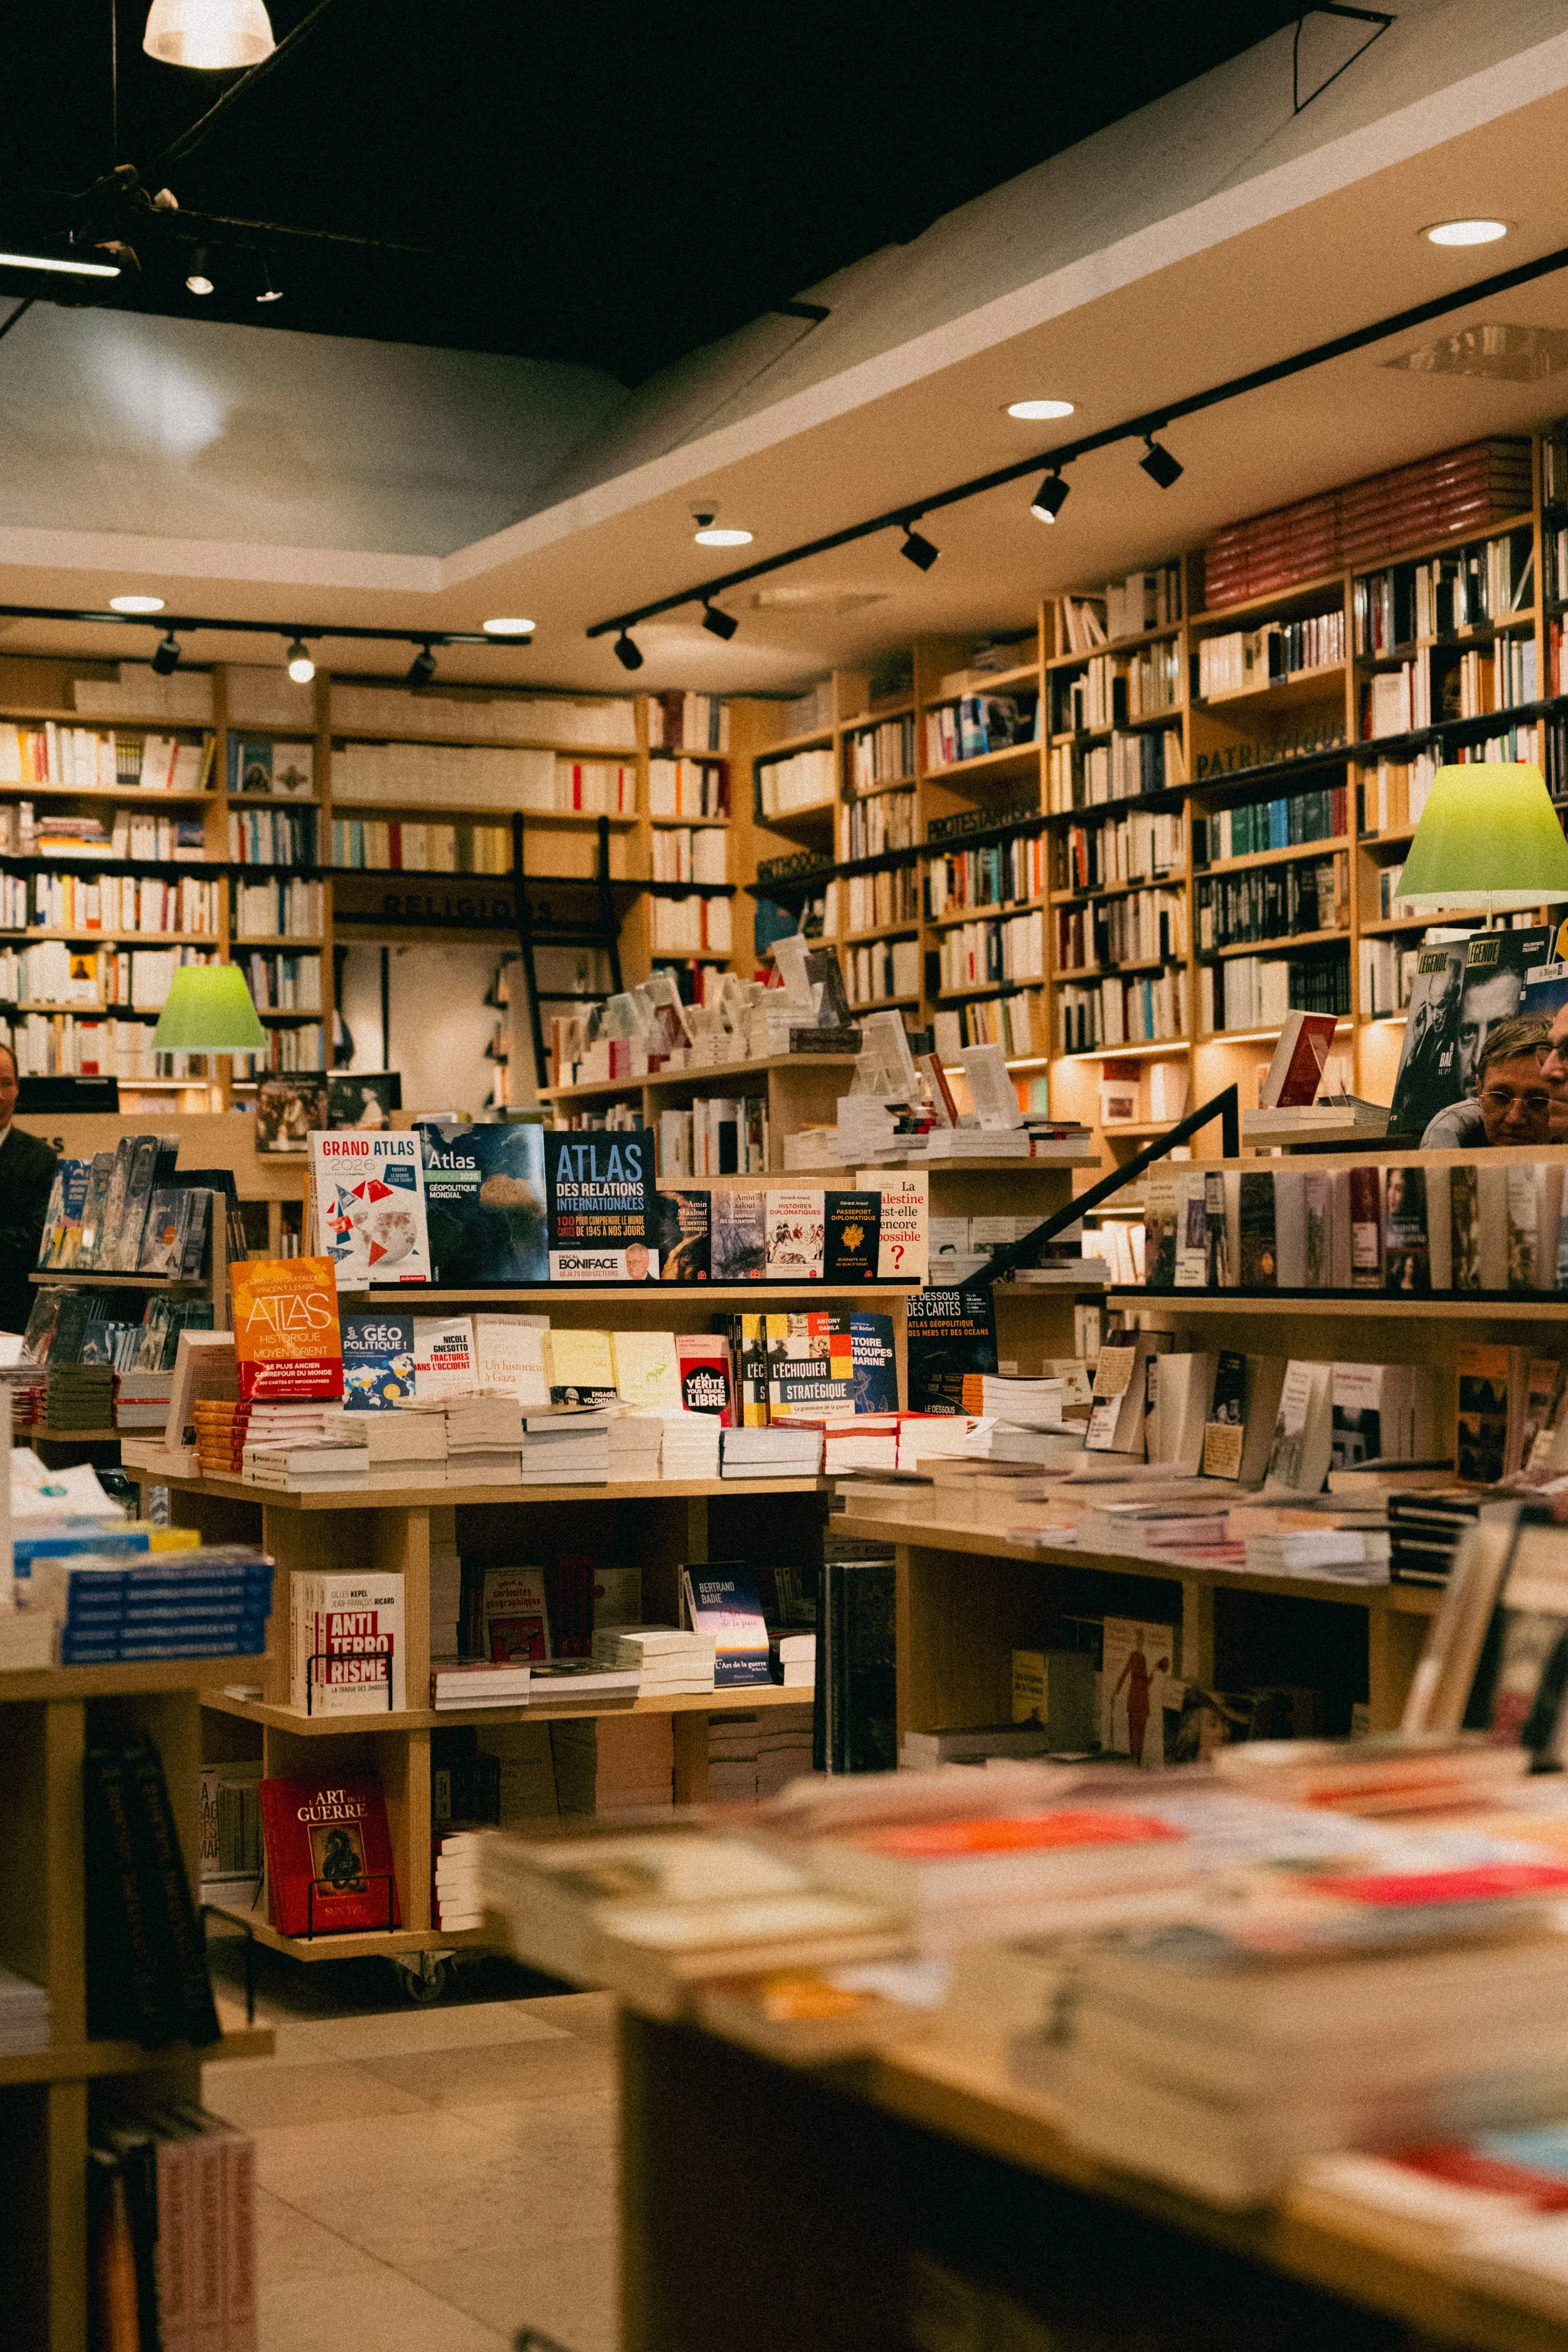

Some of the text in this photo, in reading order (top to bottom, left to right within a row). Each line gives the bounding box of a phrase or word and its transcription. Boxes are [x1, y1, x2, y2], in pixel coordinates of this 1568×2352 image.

[383, 894, 553, 919] RELIGIOS
[1467, 941, 1499, 964] LÉGENDE
[1418, 952, 1448, 974] LÉGENDE
[323, 1141, 414, 1156] GRAND ATLAS
[331, 1159, 375, 1170] 2026
[428, 1151, 475, 1169] Atlas
[556, 1144, 642, 1182] ATLAS
[429, 1183, 477, 1192] GÉOPOLITIQUE
[556, 1183, 644, 1197] DES RELATIONS
[902, 1182, 915, 1192] La
[557, 1197, 644, 1211] INTERNATIONALES
[558, 1216, 575, 1226] 100
[576, 1216, 645, 1226] POUR COMPRENDRE LE MONDE
[881, 1221, 917, 1229] encore
[558, 1227, 575, 1237] CARTES
[576, 1226, 585, 1236] DE
[586, 1226, 601, 1236] 1945
[608, 1226, 622, 1236] NOS
[623, 1226, 645, 1236] JOURS
[891, 1244, 904, 1269] ?
[559, 1259, 618, 1269] BONIFACE
[919, 1292, 960, 1301] DESSOUS
[246, 1293, 331, 1333] ATLAS
[908, 1302, 961, 1316] DES CARTES
[364, 1325, 402, 1342] GÉO
[964, 1327, 988, 1335] OCÉANS
[260, 1332, 320, 1343] HISTORIQUE
[443, 1335, 467, 1343] NICOLE
[344, 1341, 406, 1351] POLITIQUE !
[434, 1343, 468, 1352] GNESOTTO
[253, 1346, 329, 1359] MOYEN-ORIENT
[430, 1353, 469, 1362] FRACTURES
[433, 1361, 470, 1371] L'OCCIDENT
[485, 1360, 542, 1372] Un historien
[853, 1357, 886, 1366] MARINE
[773, 1362, 827, 1379] L'ÉCHIQUIER
[485, 1372, 516, 1382] à Gaza
[686, 1376, 725, 1389] VÉRITÉ
[787, 1382, 847, 1400] STRATÉGIQUE
[688, 1394, 726, 1406] LIBRE
[932, 1406, 955, 1414] DESSOUS
[699, 1582, 735, 1593] BERTRAND
[701, 1593, 723, 1604] BADIE
[331, 1613, 372, 1636] ANTI
[742, 1619, 758, 1628] paix
[331, 1635, 389, 1655] TERRO
[331, 1658, 387, 1683] RISME
[297, 1803, 368, 1821] GUERRE
